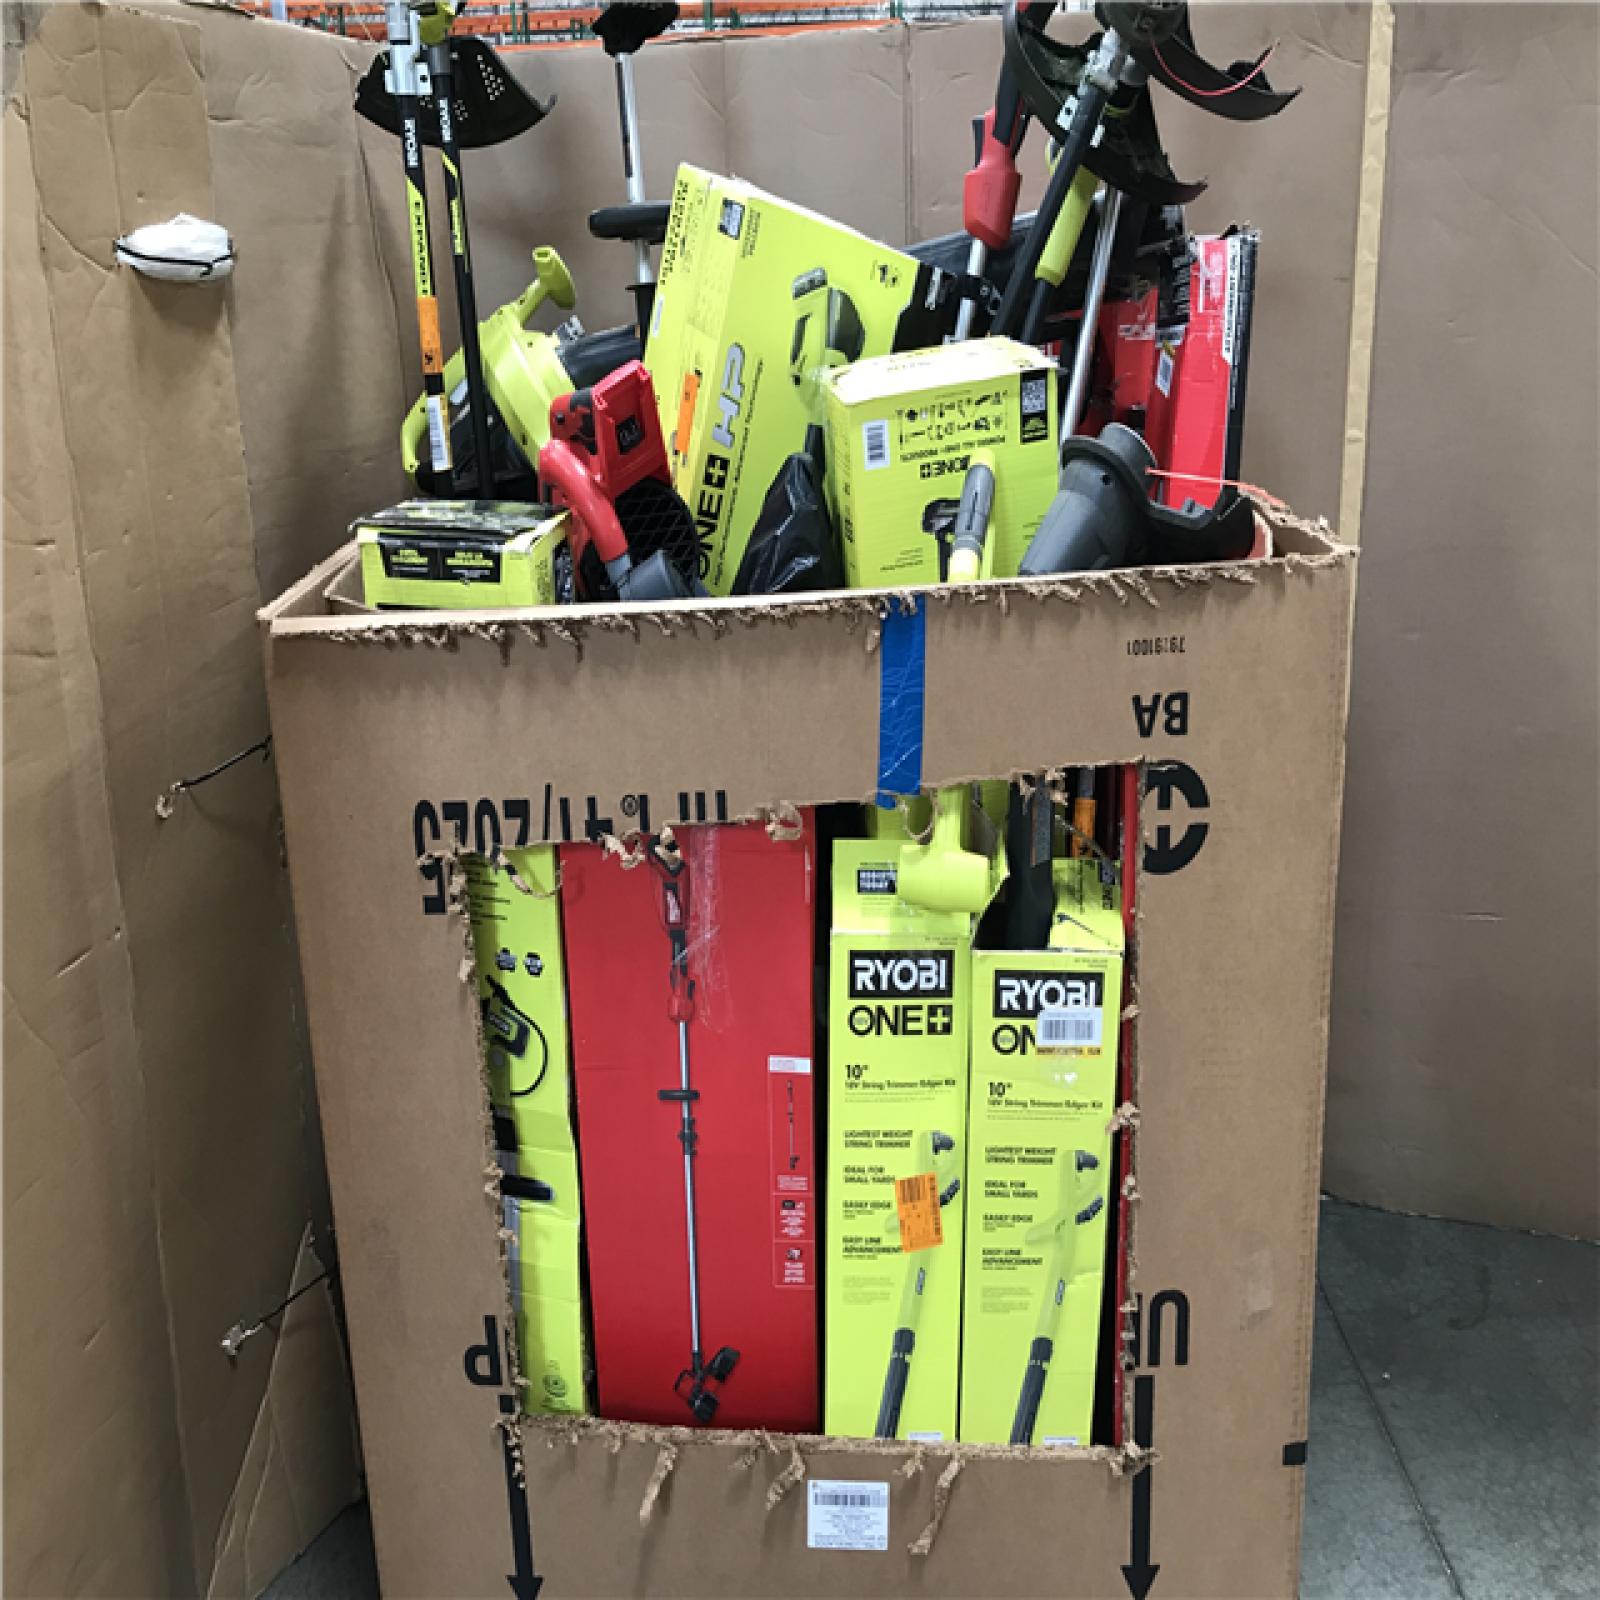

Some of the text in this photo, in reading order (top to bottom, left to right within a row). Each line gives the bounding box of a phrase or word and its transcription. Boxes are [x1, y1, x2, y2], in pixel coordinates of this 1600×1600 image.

[712, 341, 745, 449] HP
[1131, 692, 1190, 738] BA
[854, 959, 948, 992] RYOBI
[999, 979, 1096, 1011] RYOBI
[992, 1024, 1037, 1056] ON
